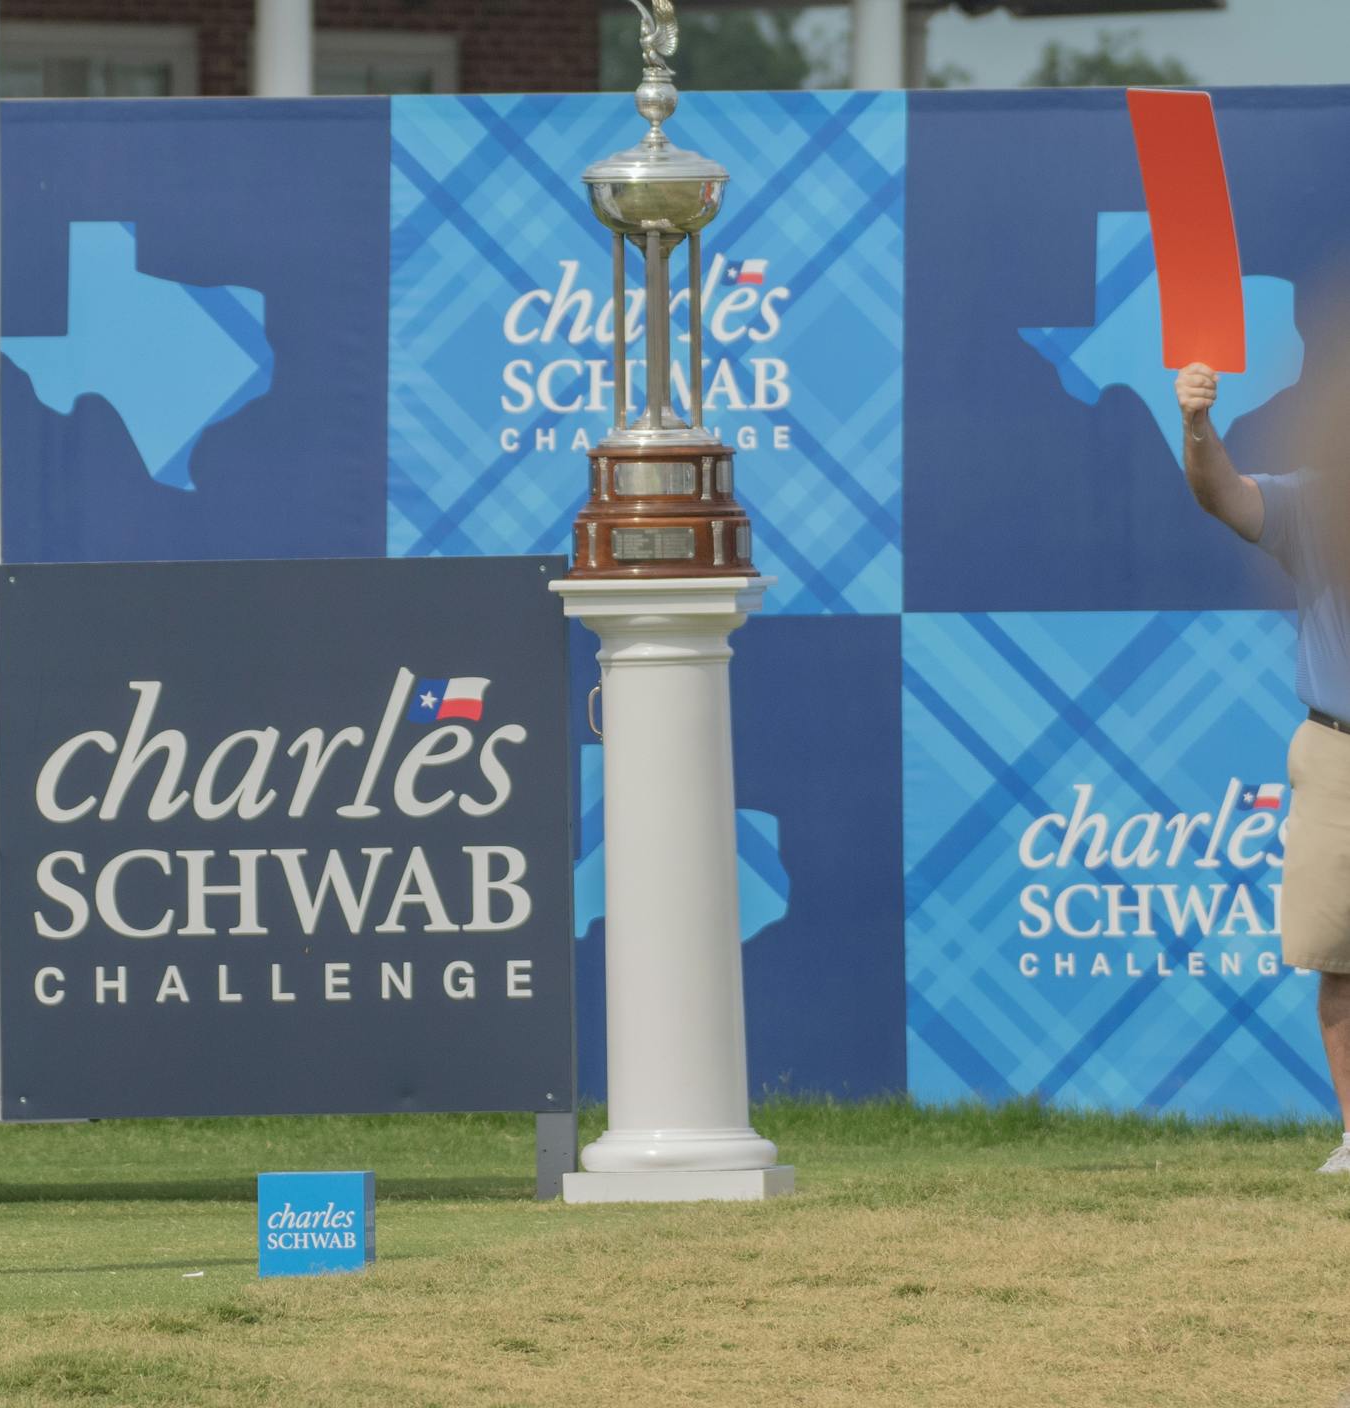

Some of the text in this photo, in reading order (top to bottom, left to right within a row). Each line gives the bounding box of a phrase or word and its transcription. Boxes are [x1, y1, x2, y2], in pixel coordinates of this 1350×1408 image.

[35, 666, 527, 823] charles
[33, 844, 532, 941] SCHWAB
[1018, 883, 1283, 938] SCHWA
[34, 959, 533, 1006] CHALLENGE
[267, 1201, 355, 1229] charles
[267, 1231, 356, 1250] SCHWAB
